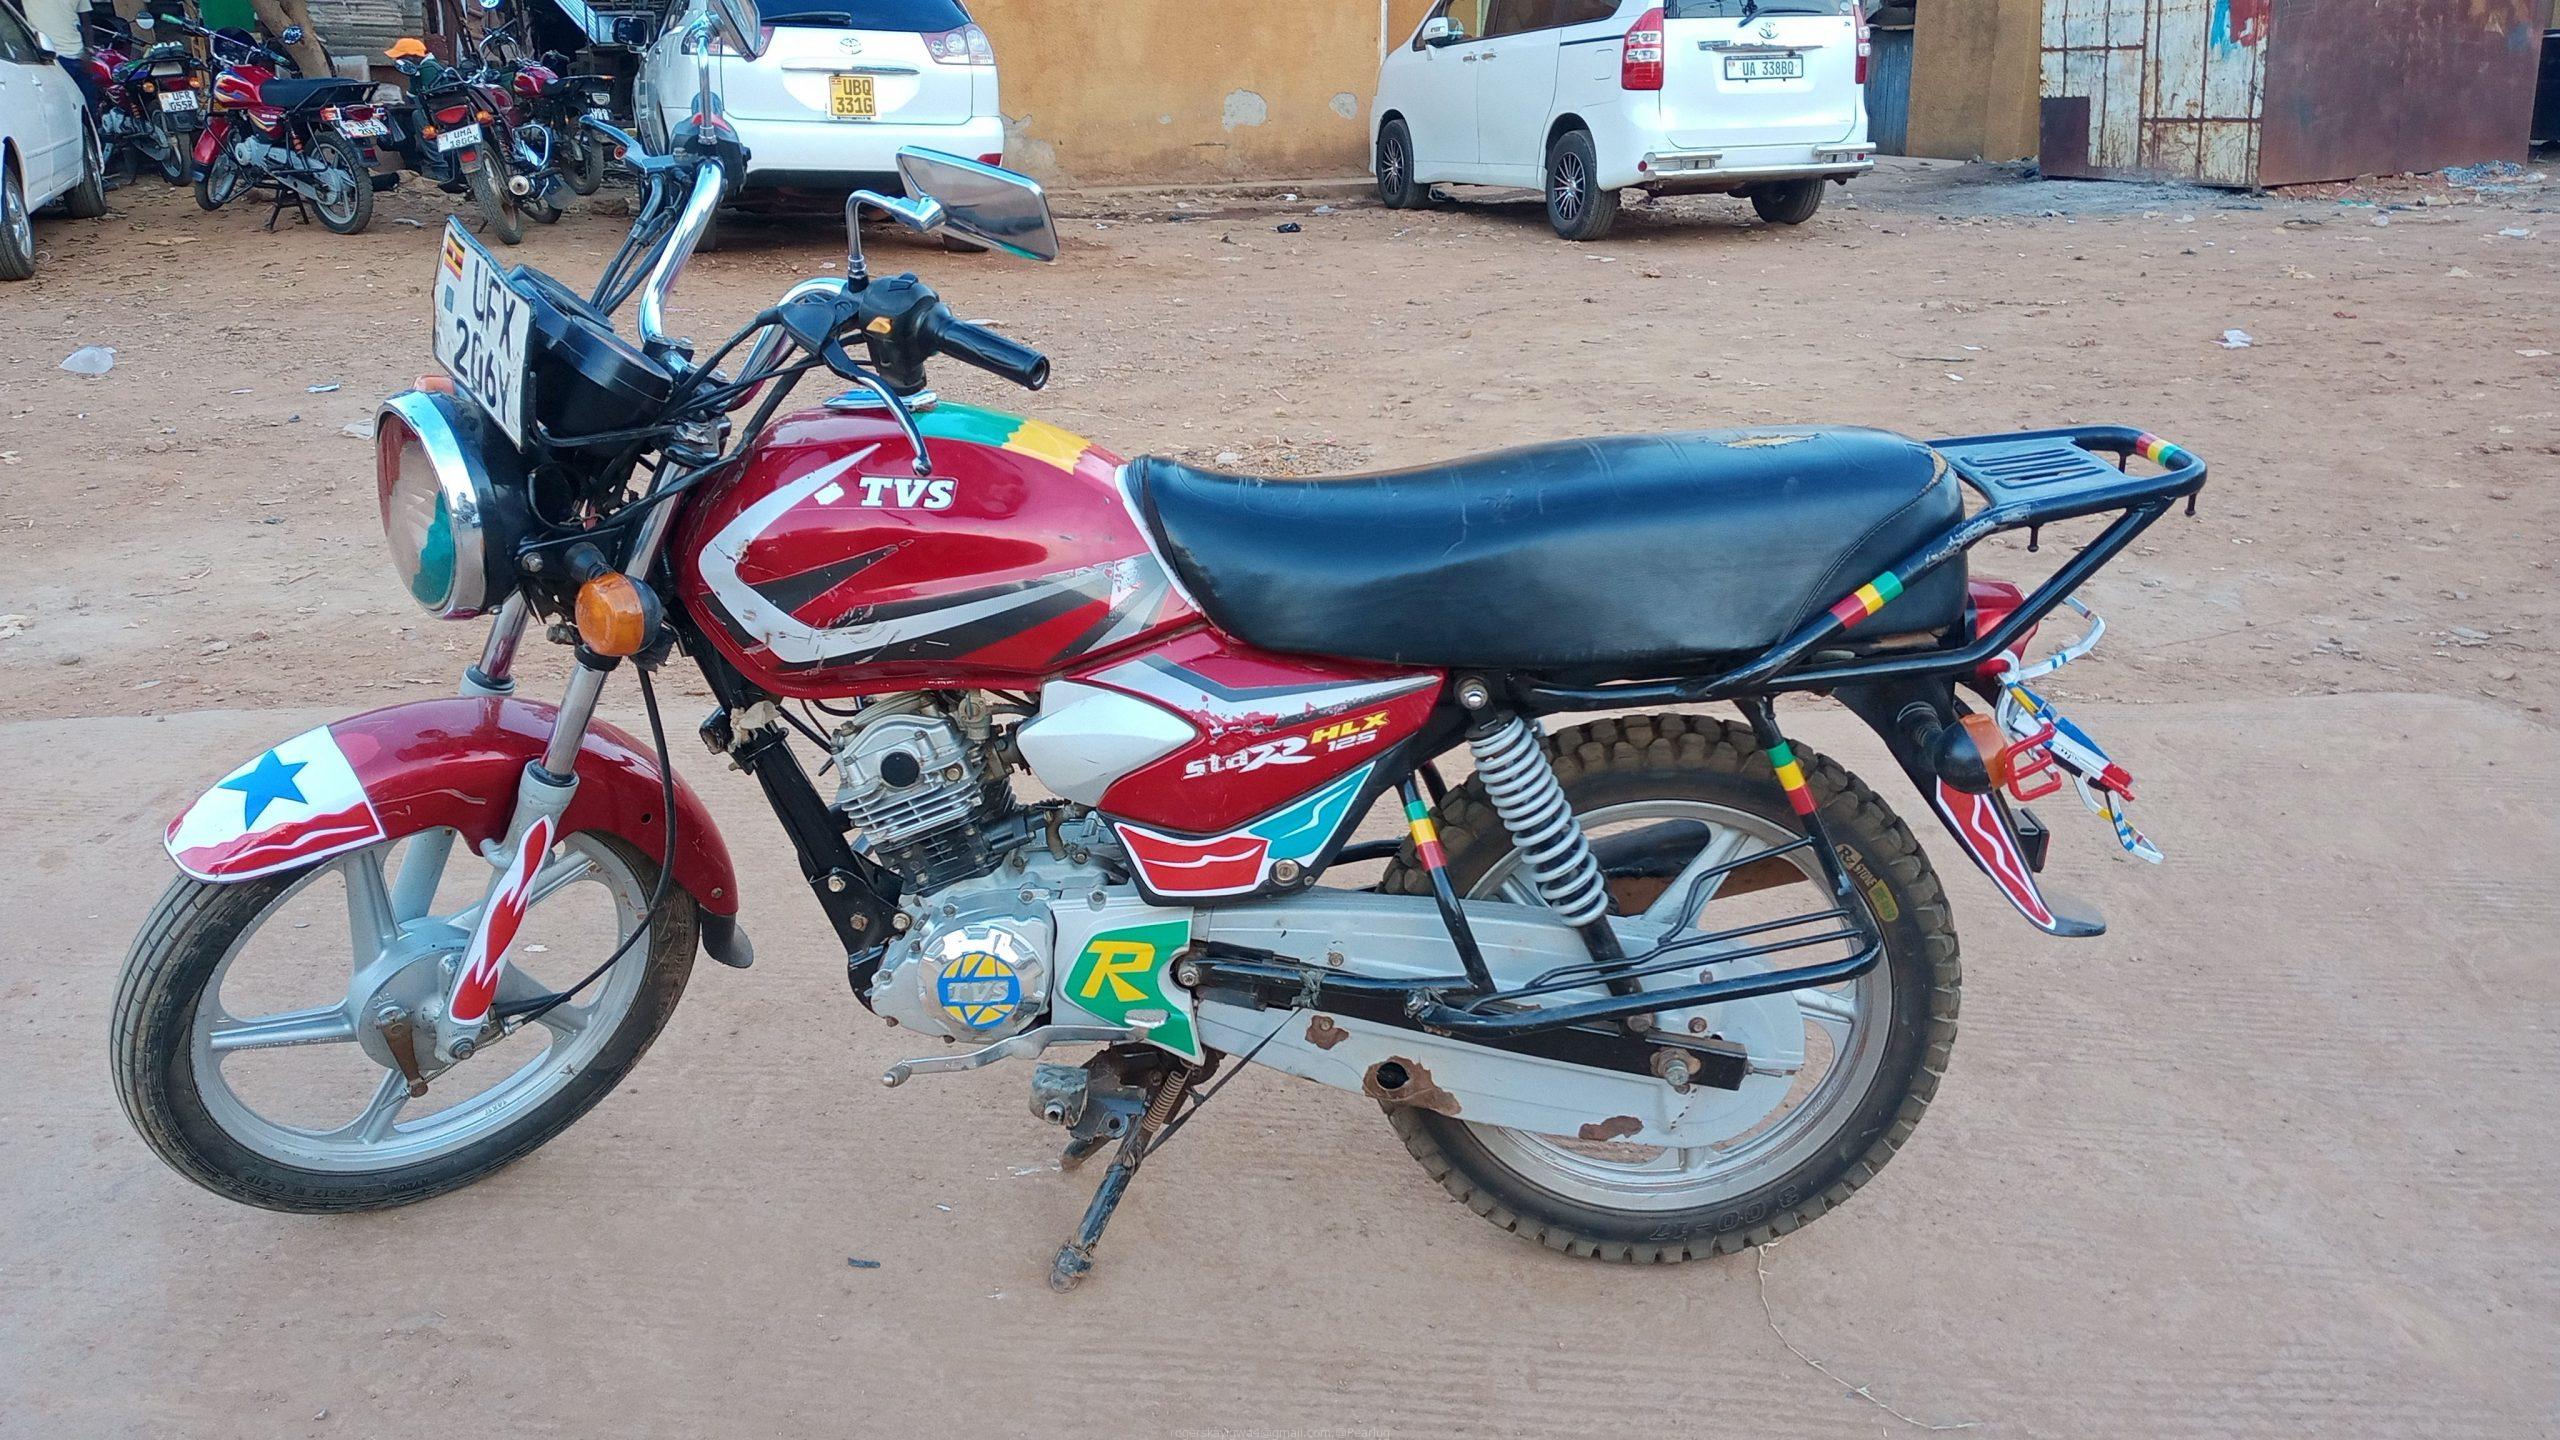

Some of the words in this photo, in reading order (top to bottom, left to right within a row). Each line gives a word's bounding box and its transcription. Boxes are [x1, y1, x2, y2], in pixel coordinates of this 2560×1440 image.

[1742, 62, 1756, 76] UA
[1762, 61, 1794, 76] 338BQ
[172, 91, 191, 100] UFR
[843, 79, 871, 96] UBQ
[836, 97, 873, 113] 331G
[473, 258, 516, 360] UFX
[453, 317, 511, 425] 206Y
[859, 476, 955, 509] TVS
[1311, 710, 1389, 744] HLX
[1327, 729, 1379, 753] 125
[1080, 940, 1156, 1002] R
[947, 981, 1009, 1002] TVS
